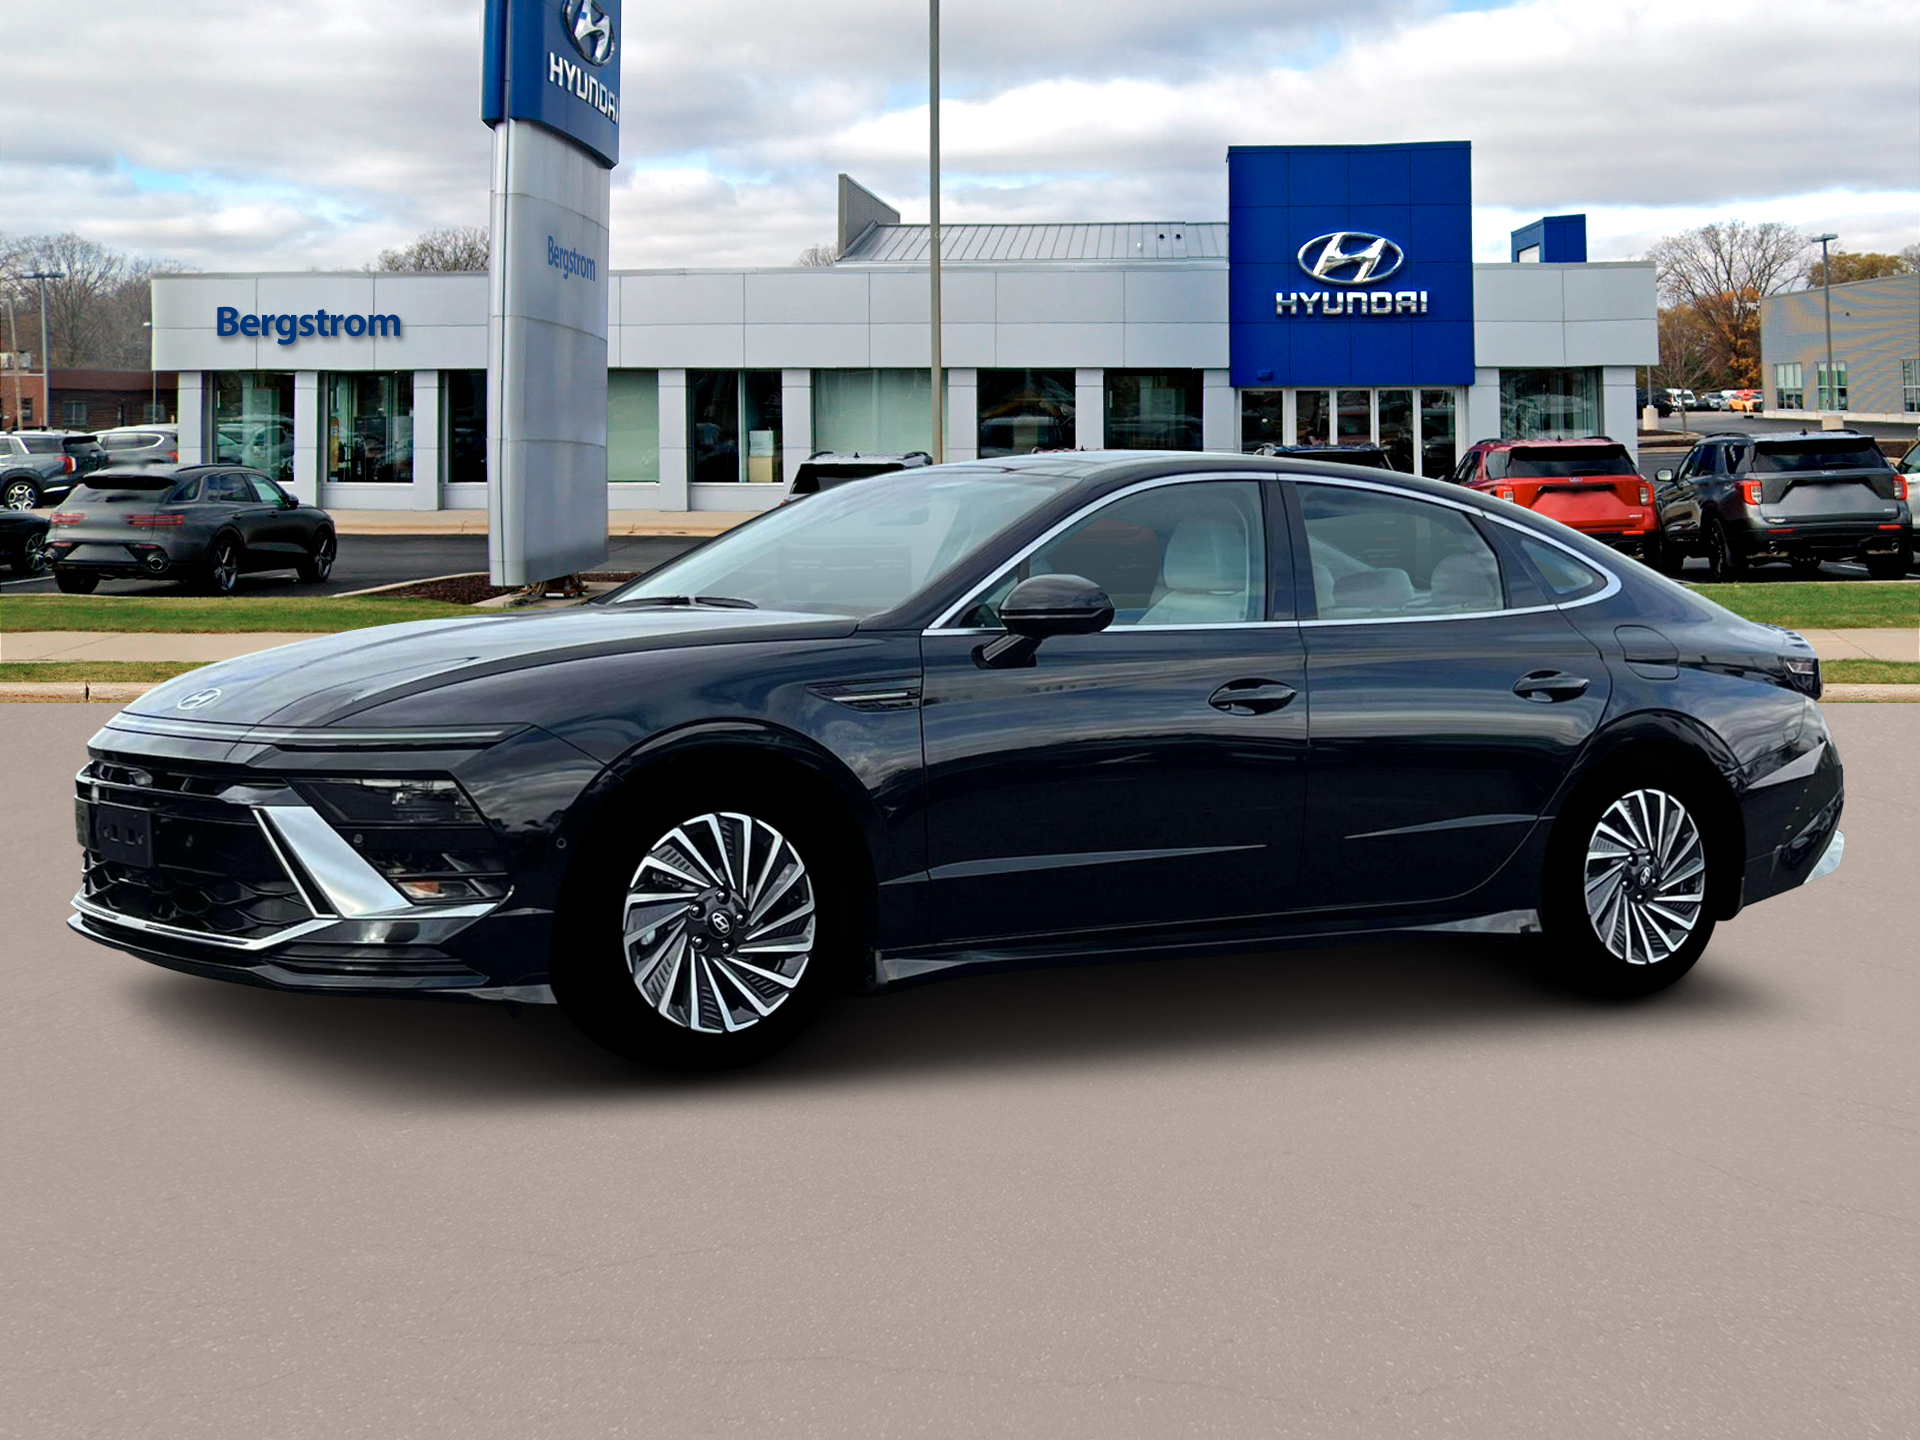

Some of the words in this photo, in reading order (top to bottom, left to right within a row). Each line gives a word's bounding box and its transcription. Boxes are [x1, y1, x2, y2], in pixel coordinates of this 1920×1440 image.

[548, 52, 619, 124] HYUNDAI
[547, 235, 596, 281] Bergstrom
[1275, 291, 1428, 315] HYUNDAI
[217, 306, 401, 345] Bergstrom
